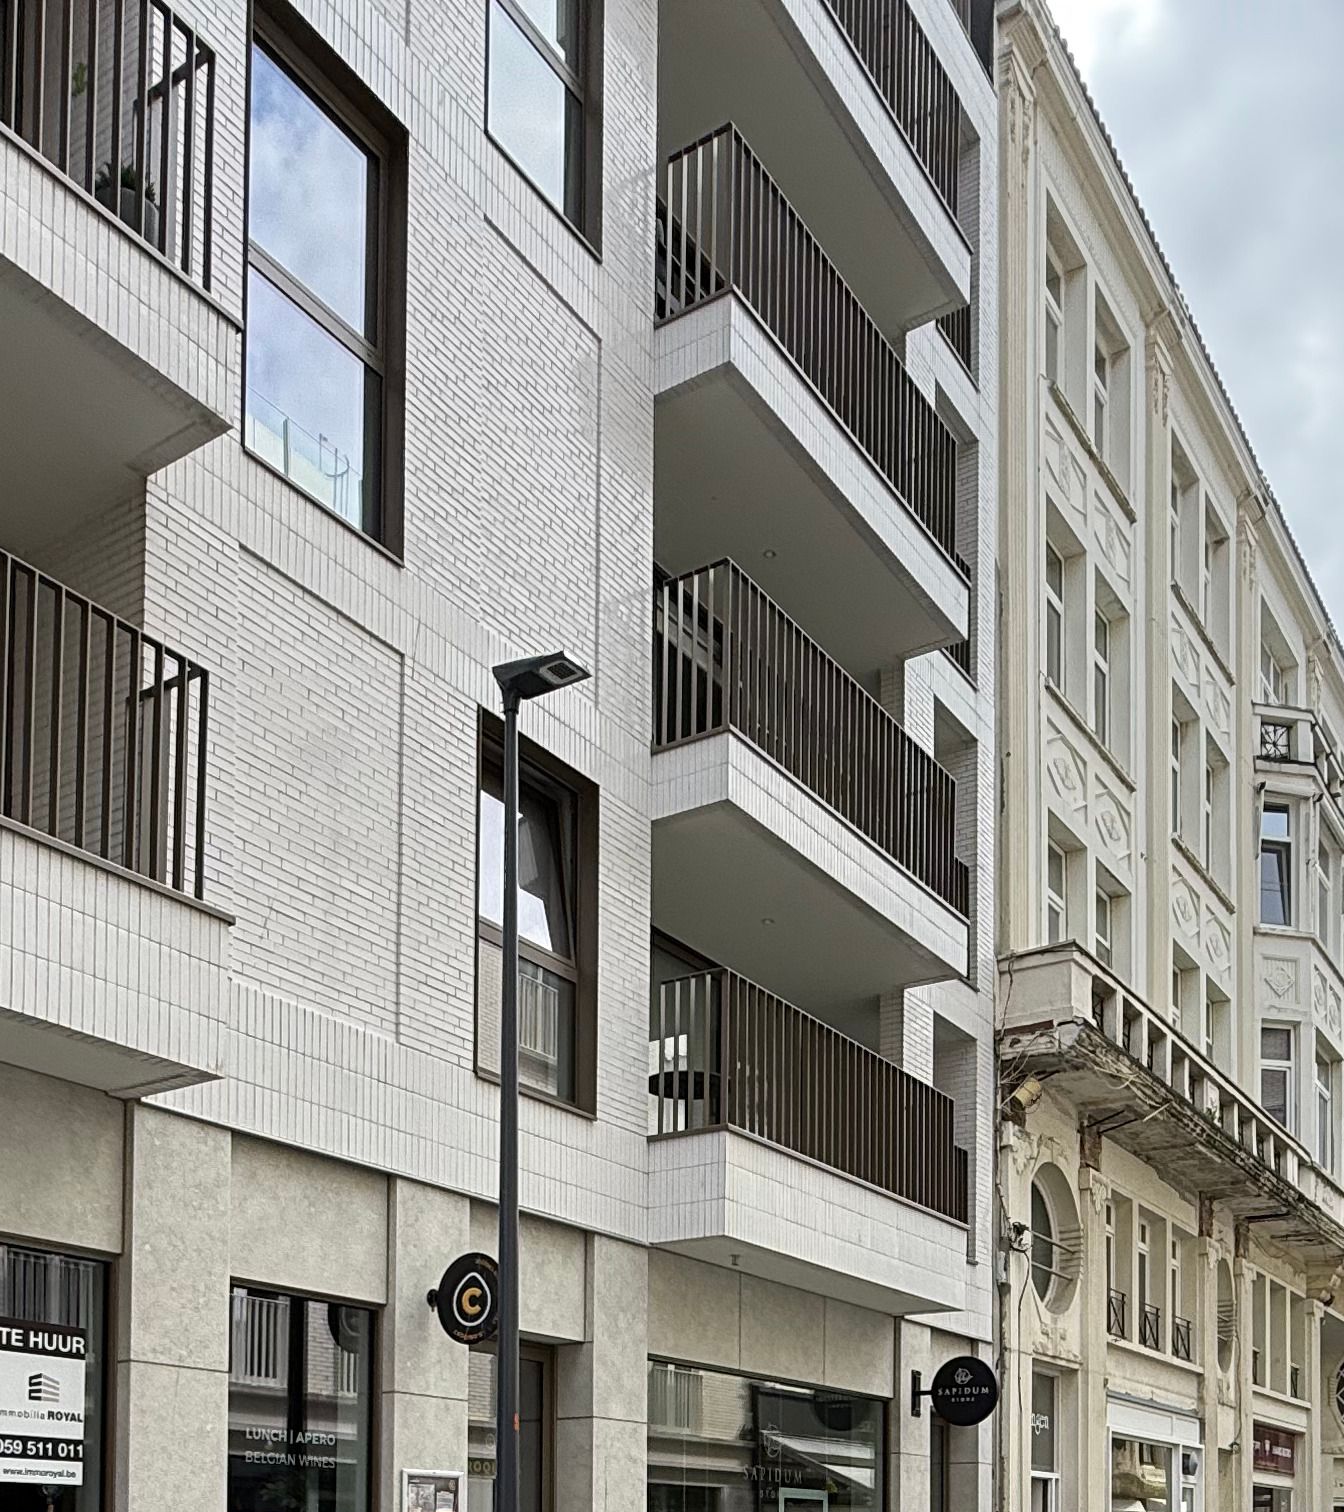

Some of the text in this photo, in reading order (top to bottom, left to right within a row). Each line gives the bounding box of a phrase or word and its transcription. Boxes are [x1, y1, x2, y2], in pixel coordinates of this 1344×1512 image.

[461, 1287, 483, 1316] C
[28, 1330, 86, 1355] HUUR
[937, 1386, 990, 1396] SAPIDUM
[46, 1410, 84, 1423] ROYAL
[245, 1427, 336, 1446] LUNCH APERO
[26, 1440, 53, 1457] 511
[57, 1442, 84, 1458] 011
[244, 1450, 336, 1469] BELGIAN WINES
[743, 1463, 802, 1485] SAPIDUM
